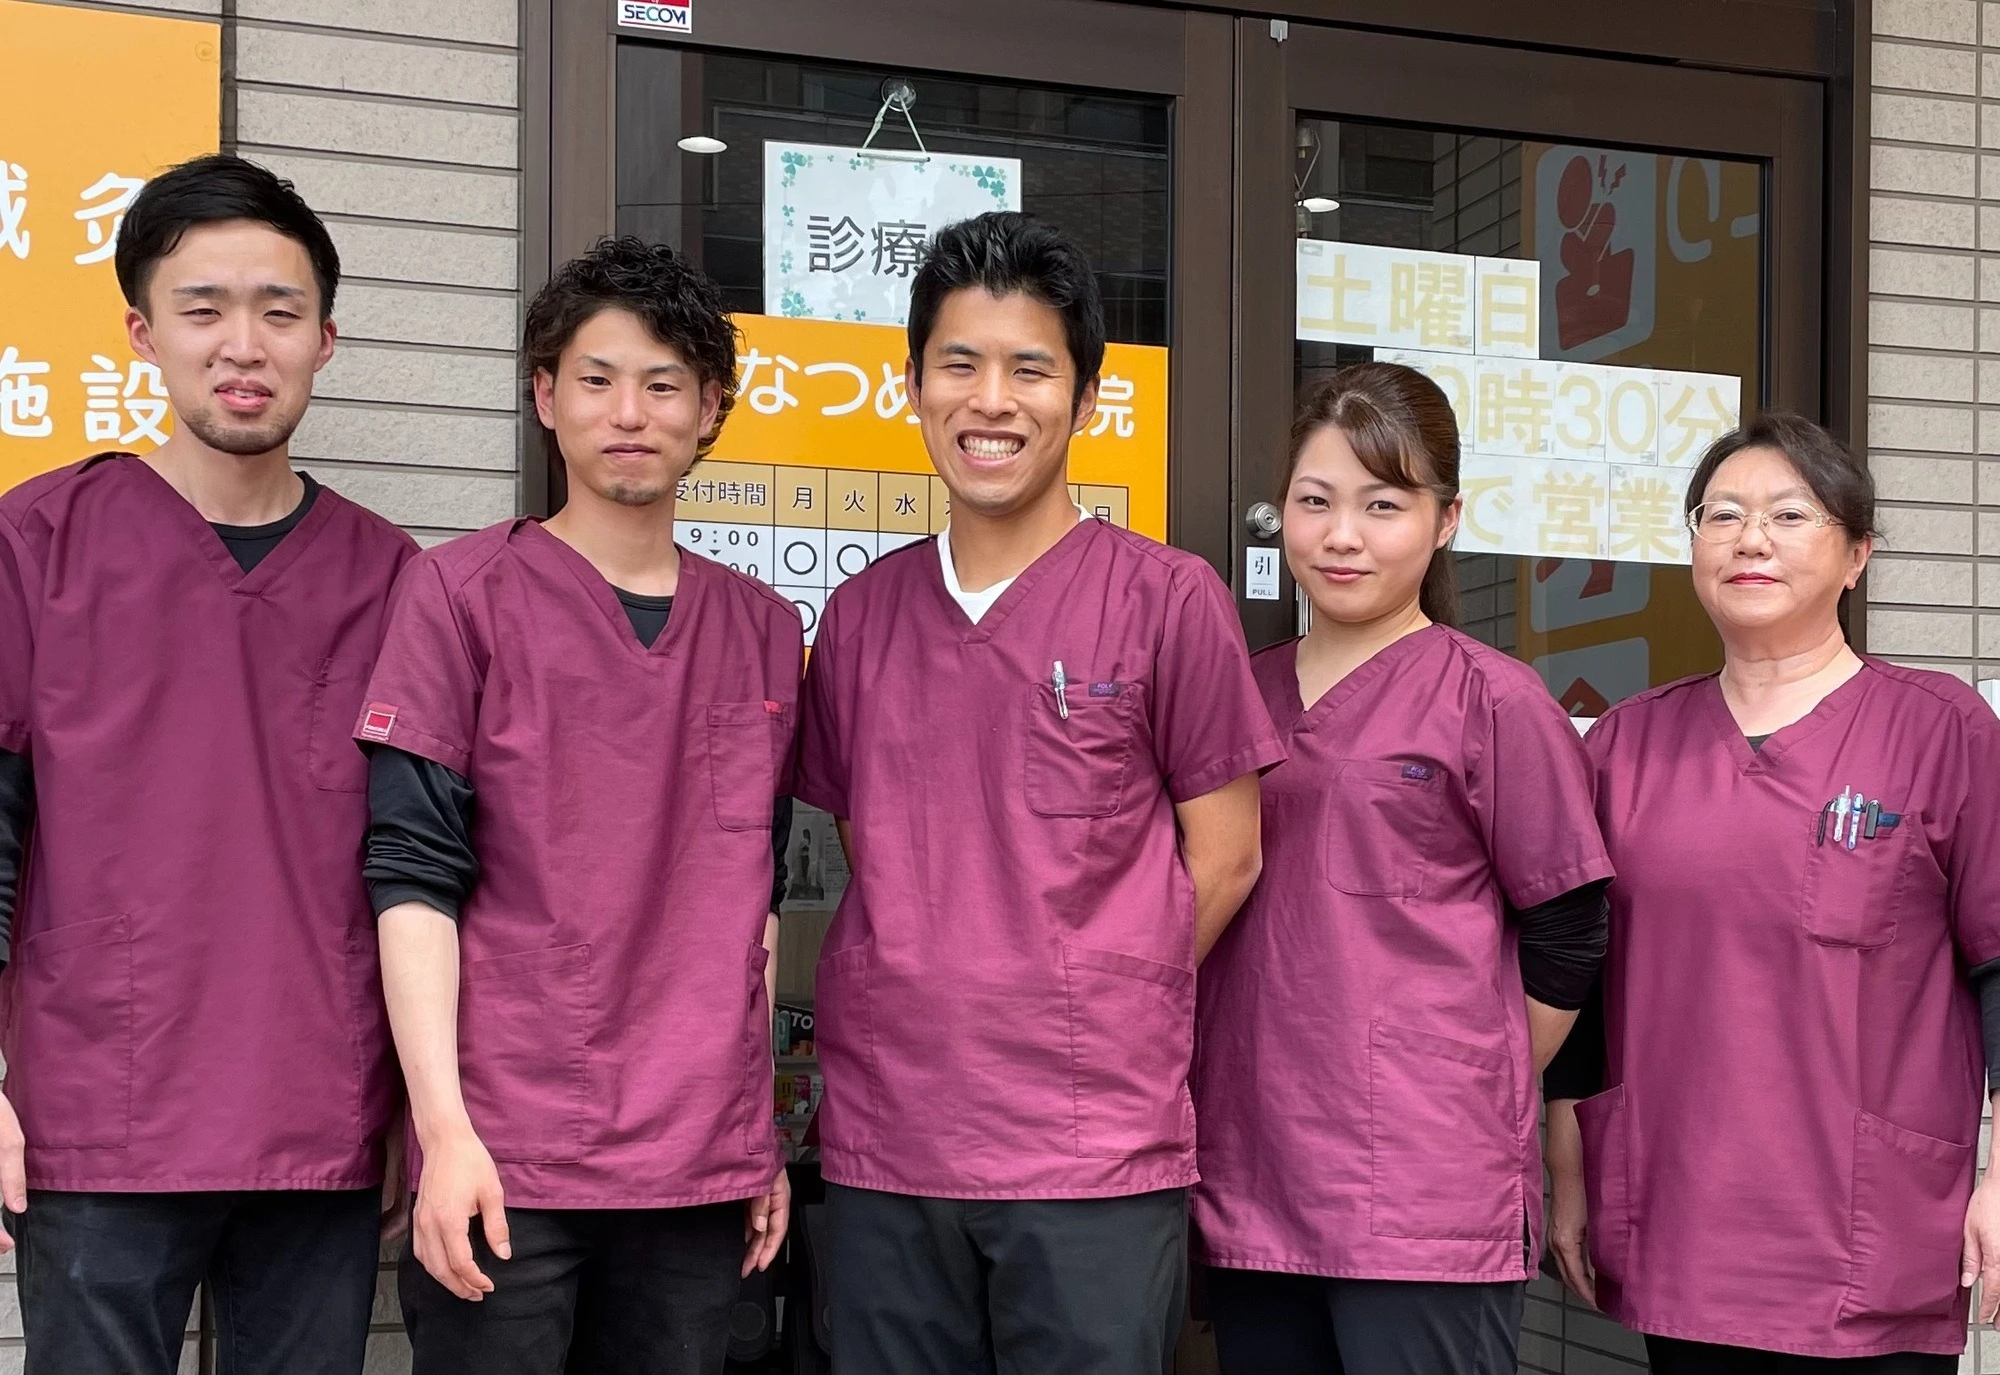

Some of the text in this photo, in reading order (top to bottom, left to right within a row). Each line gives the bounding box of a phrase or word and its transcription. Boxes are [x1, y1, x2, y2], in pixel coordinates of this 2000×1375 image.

[624, 4, 686, 25] SECOM
[807, 215, 929, 278] 診療
[1300, 254, 1537, 348] 土曜日
[0, 346, 170, 447] 施設
[675, 479, 766, 506] 受付時間
[792, 486, 813, 510] 月
[844, 489, 866, 513] 火
[894, 492, 916, 516] 水
[1461, 470, 1680, 560] で営業
[690, 527, 759, 547] 9:00
[1255, 556, 1270, 576] 引
[1252, 589, 1273, 597] PULL
